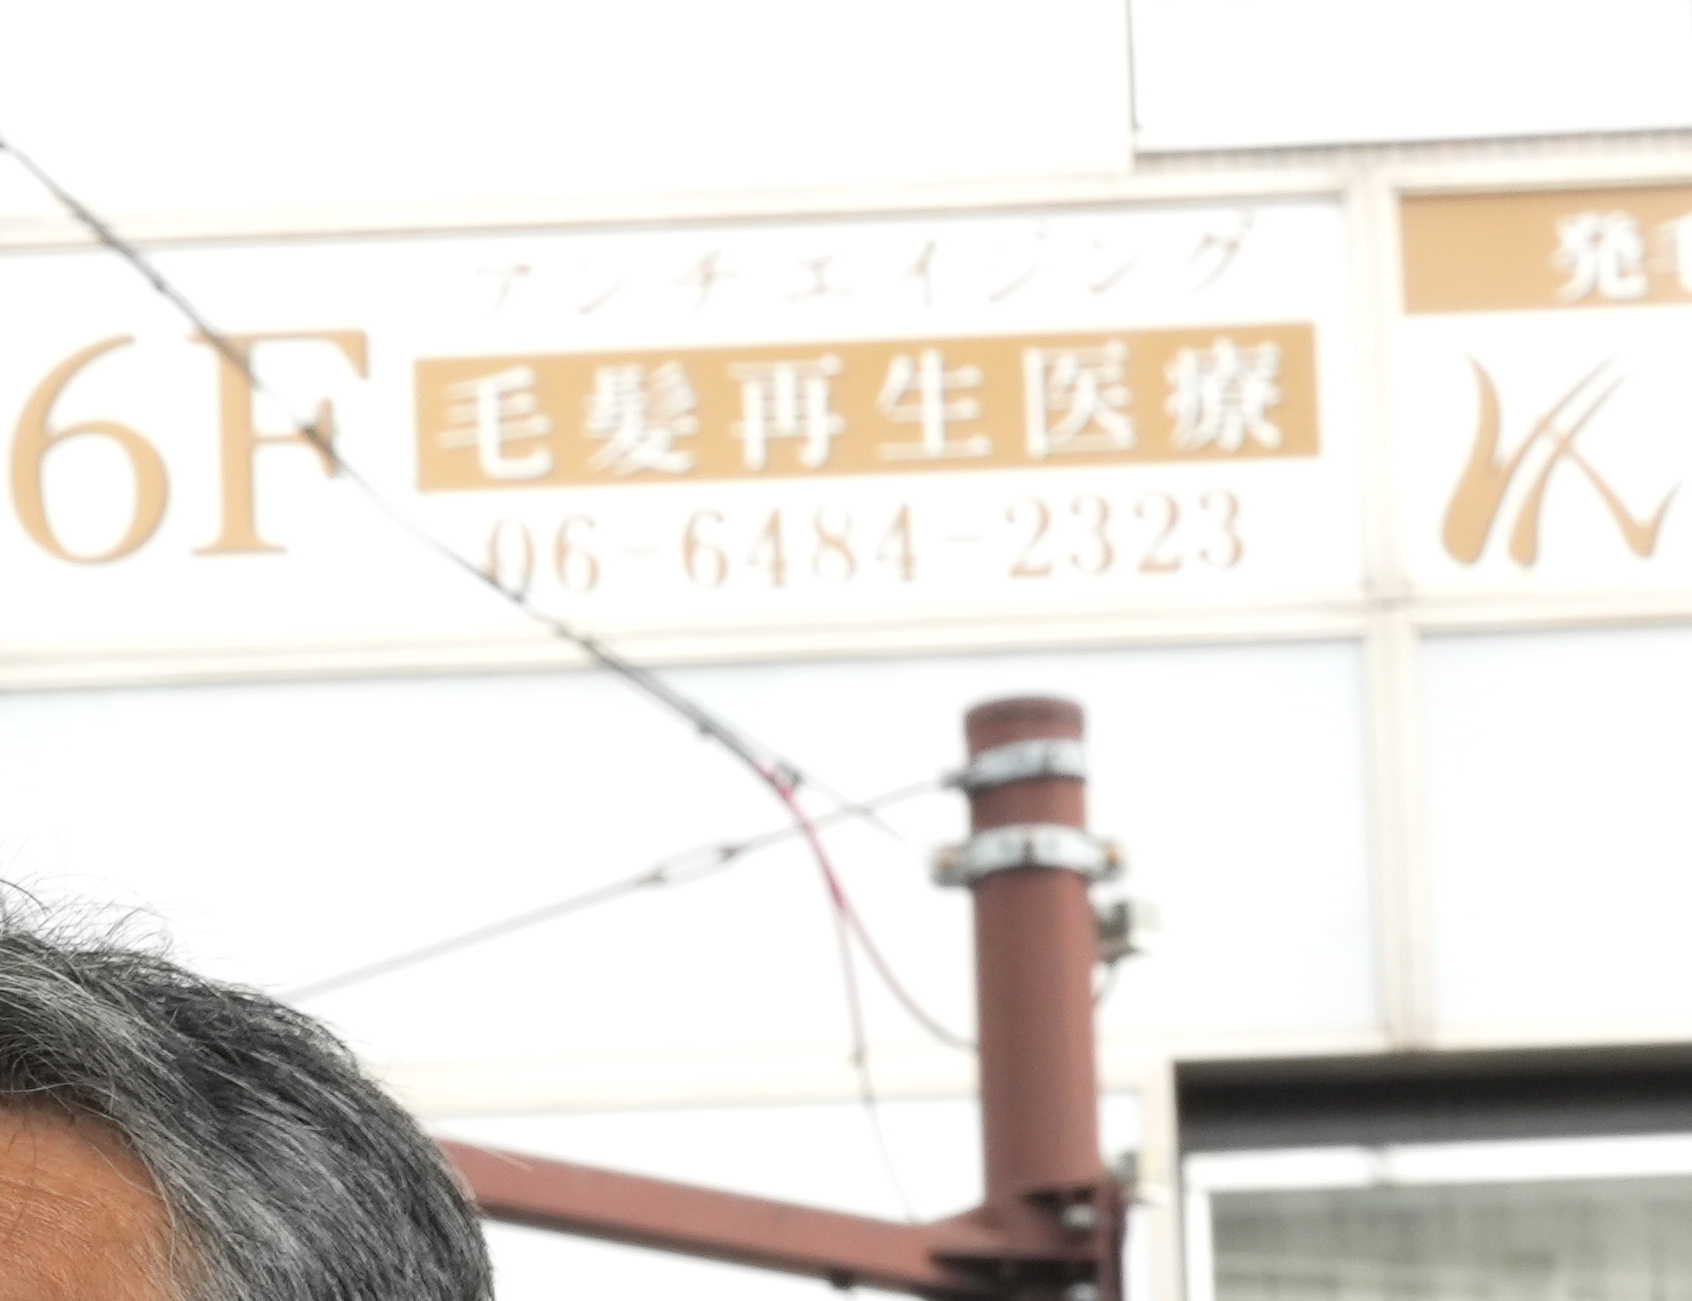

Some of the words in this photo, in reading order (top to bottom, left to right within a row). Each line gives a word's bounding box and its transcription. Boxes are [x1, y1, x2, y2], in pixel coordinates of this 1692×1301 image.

[475, 212, 1259, 318] アンチエイジング
[7, 327, 371, 567] 6F
[439, 336, 1285, 482] 毛髪再生医療
[481, 487, 1245, 596] 06-6484-2323
